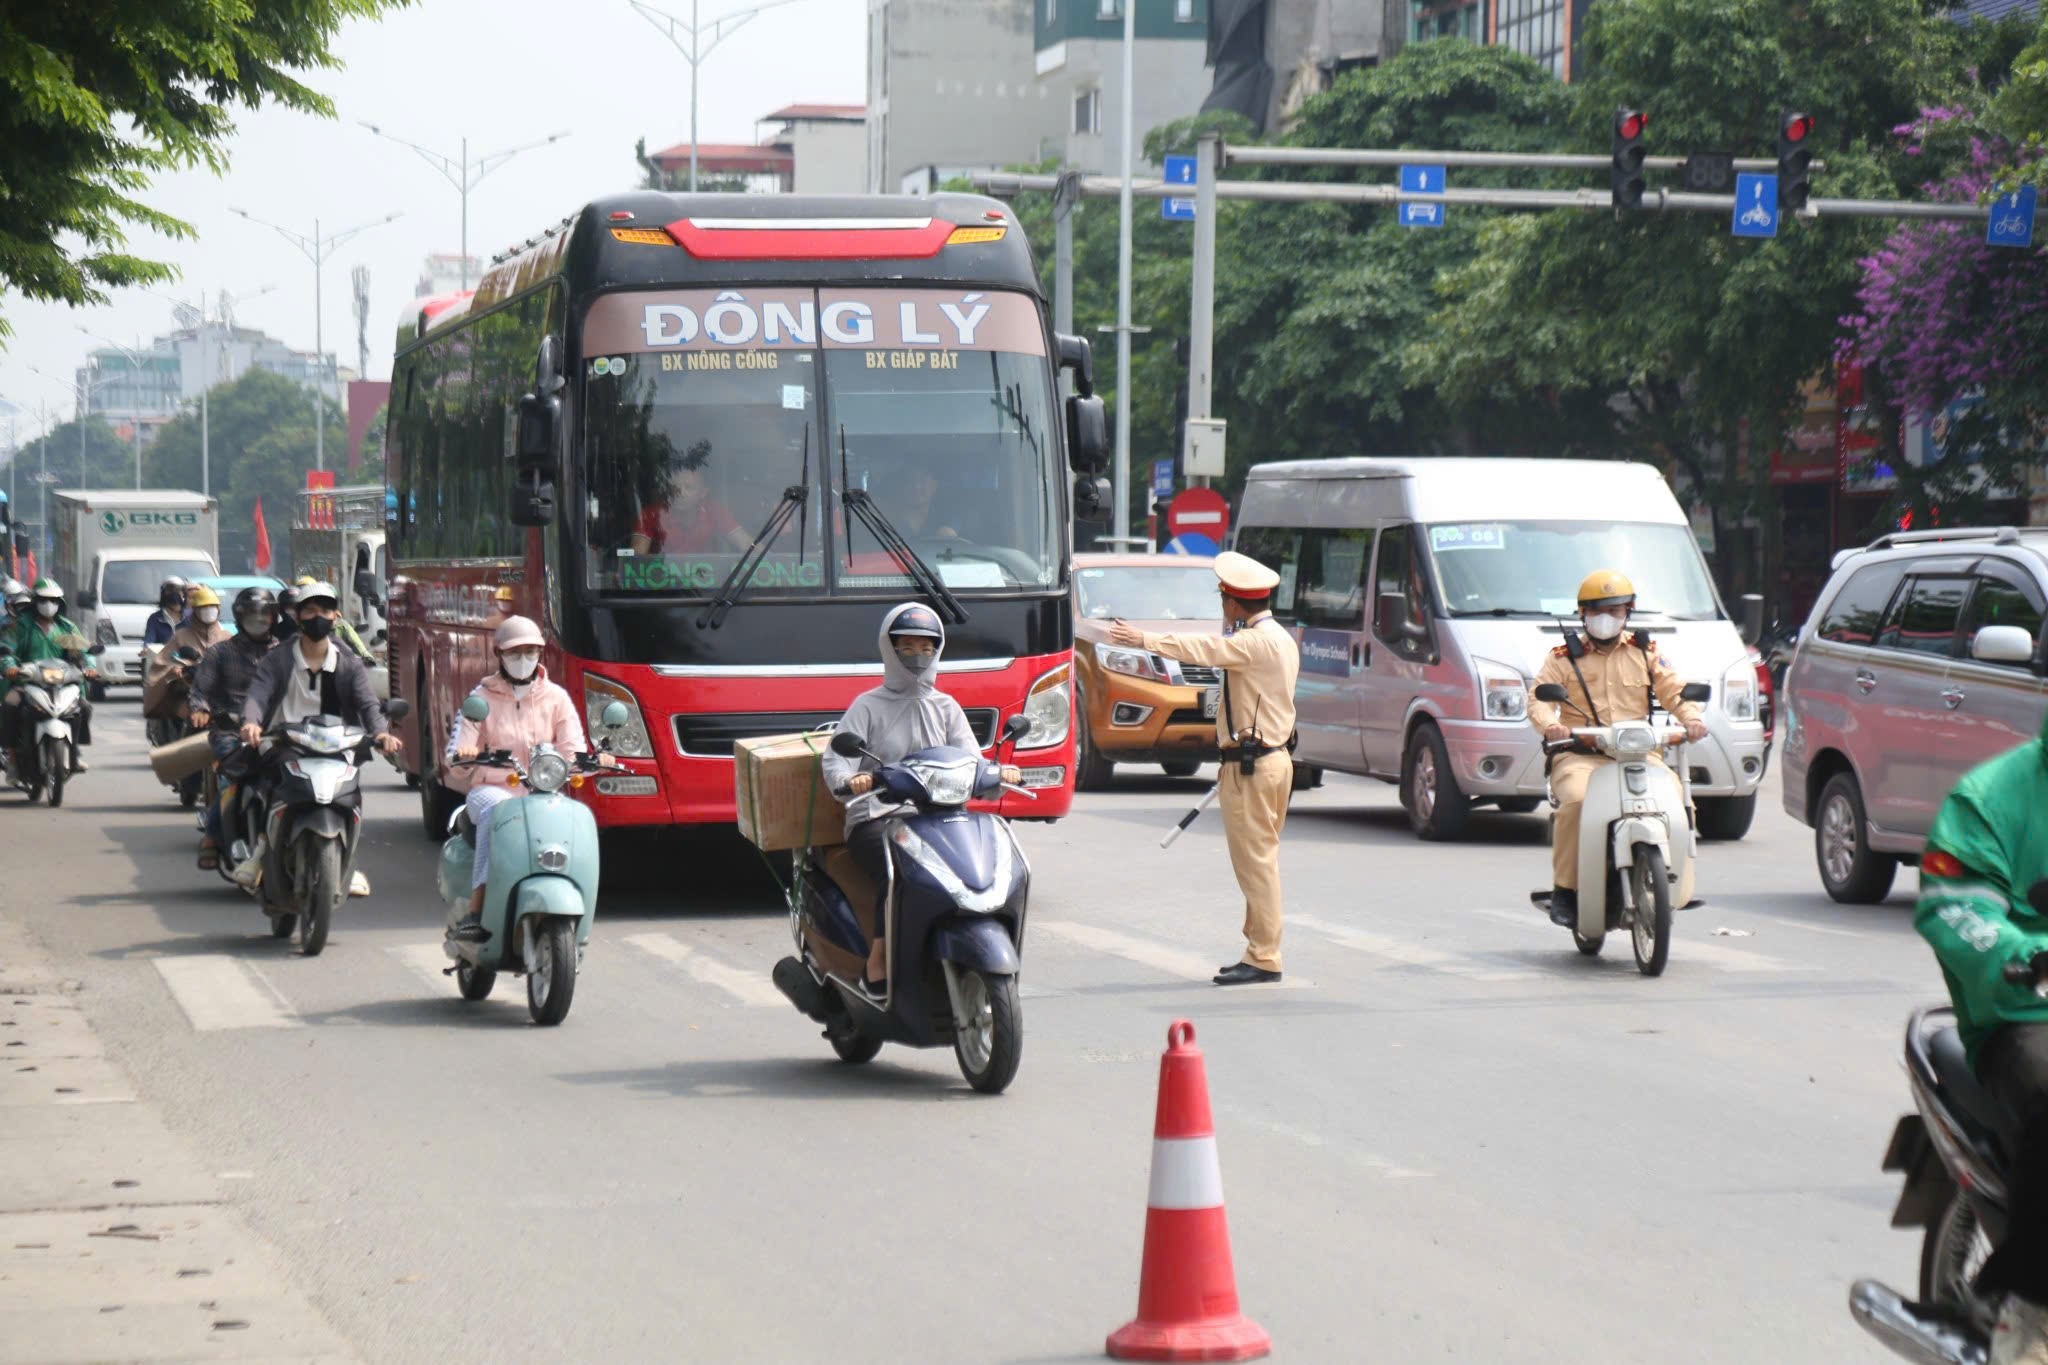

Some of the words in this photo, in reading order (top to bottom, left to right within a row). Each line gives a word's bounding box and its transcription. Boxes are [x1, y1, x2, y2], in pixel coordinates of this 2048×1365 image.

[640, 289, 875, 347] ĐÔNG
[899, 292, 993, 346] LÝ
[661, 353, 684, 371] BX
[687, 349, 731, 370] NÔNG
[865, 352, 887, 369] BX
[890, 349, 926, 369] GIÁP
[129, 513, 197, 525] BKB
